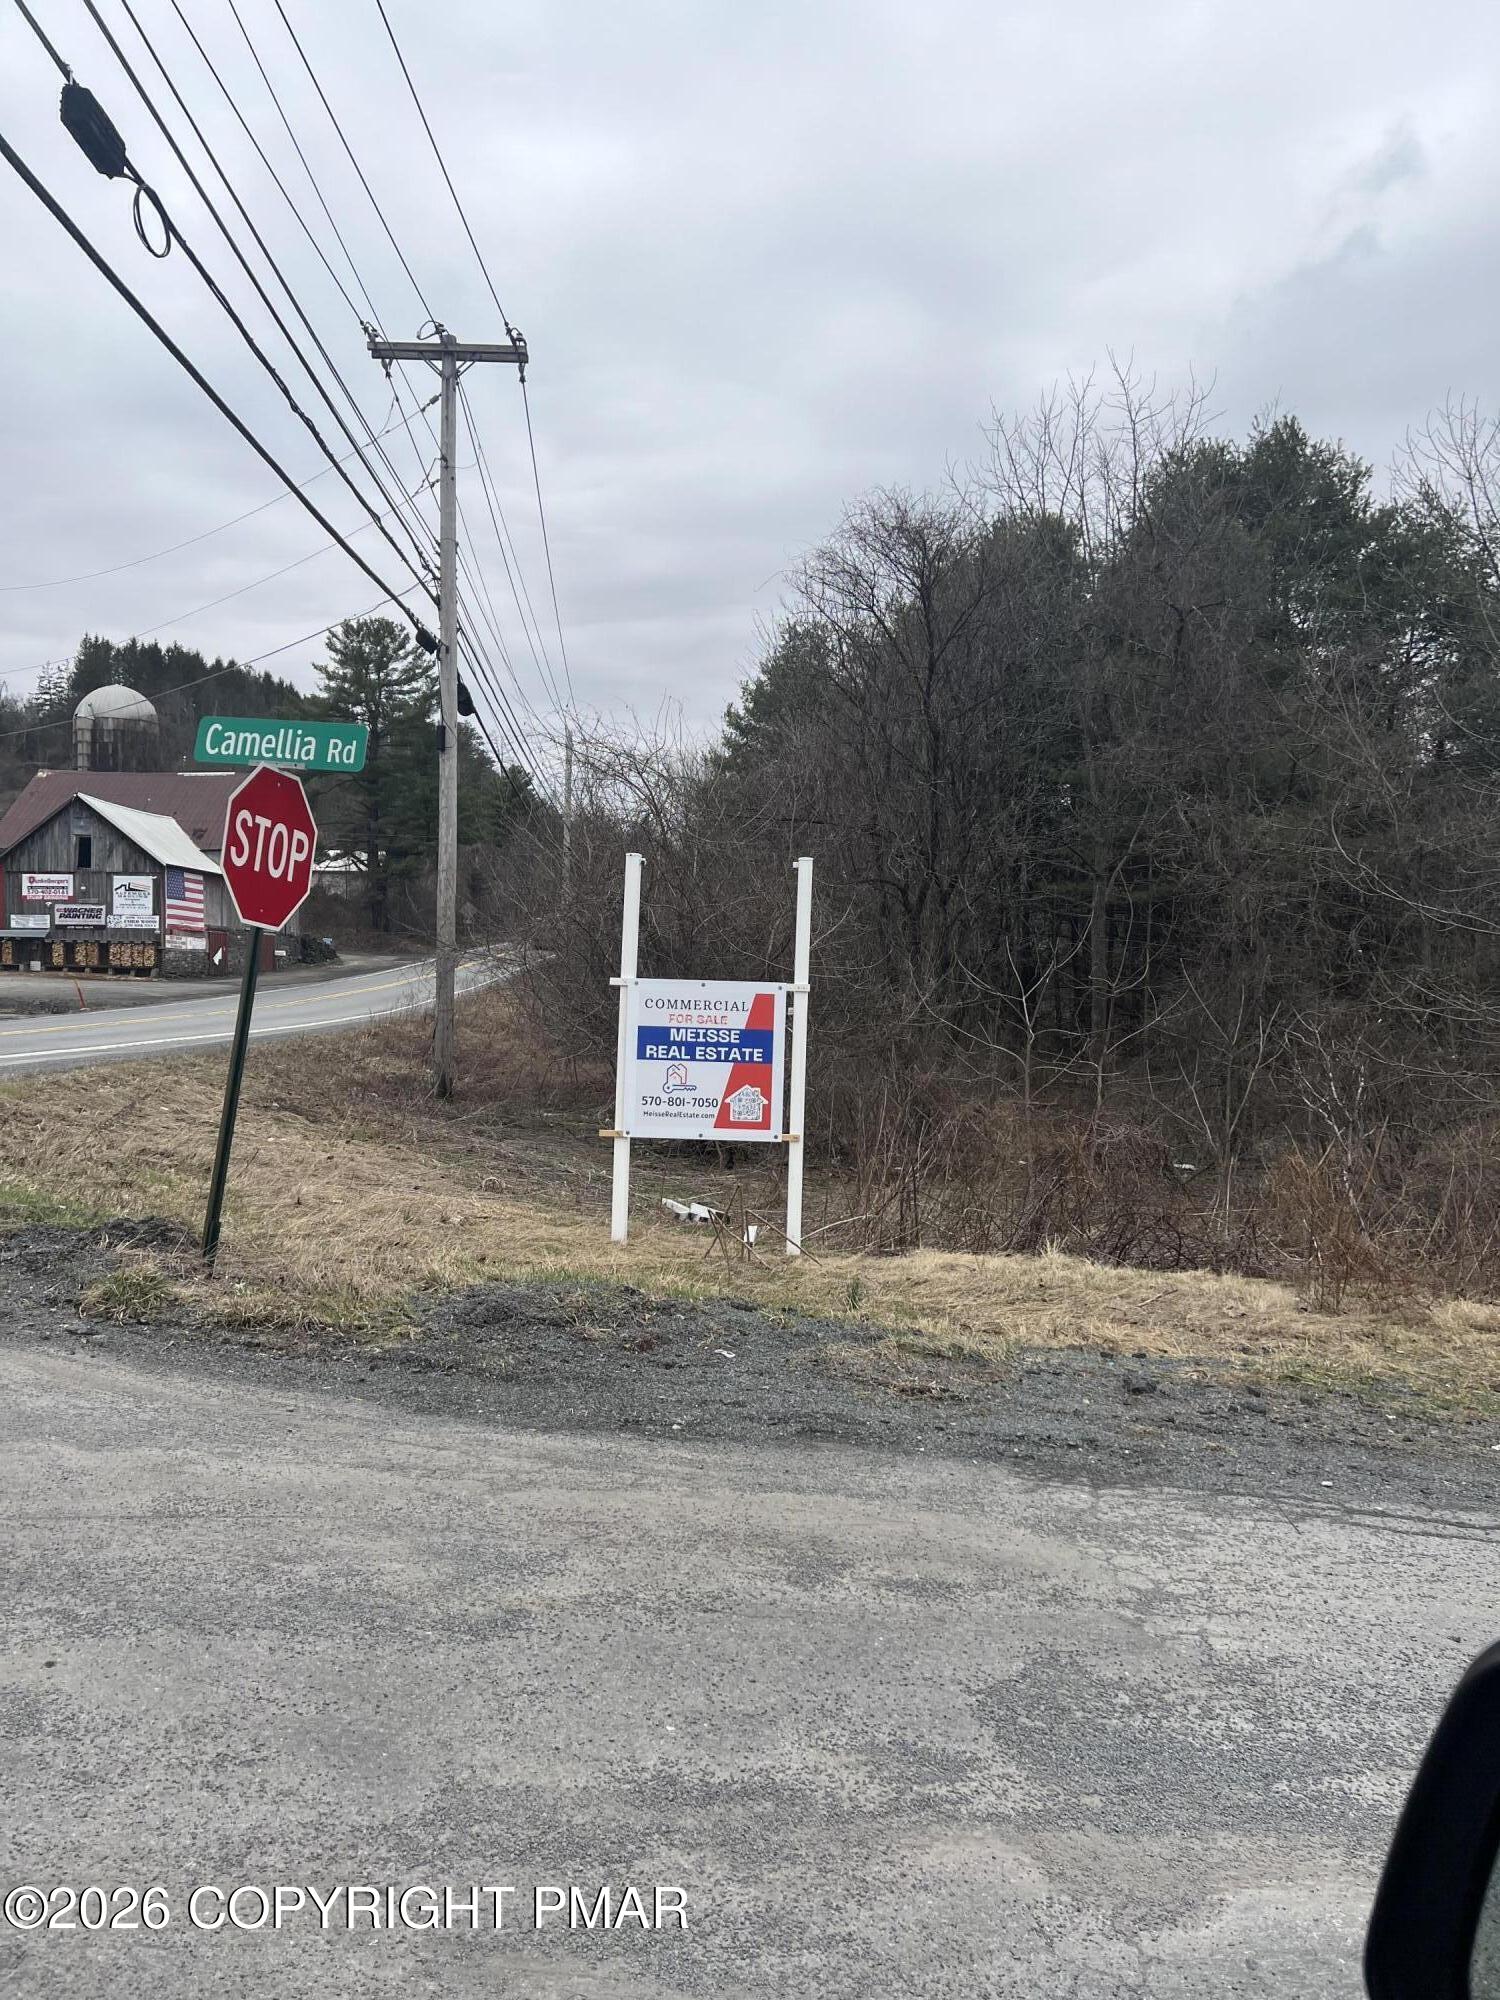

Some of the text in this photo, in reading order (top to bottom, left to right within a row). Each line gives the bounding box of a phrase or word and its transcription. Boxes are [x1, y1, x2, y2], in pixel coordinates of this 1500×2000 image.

[205, 723, 357, 764] Camellia Rd
[230, 809, 310, 882] STOP
[645, 998, 749, 1012] COMMERCIAL
[668, 1014, 728, 1025] FOR SALE
[670, 1028, 741, 1043] MEISSE
[645, 1045, 763, 1062] REAL ESTATE
[641, 1095, 719, 1108] 570-801-7050
[643, 1111, 715, 1119] MeisseRealEstate.com
